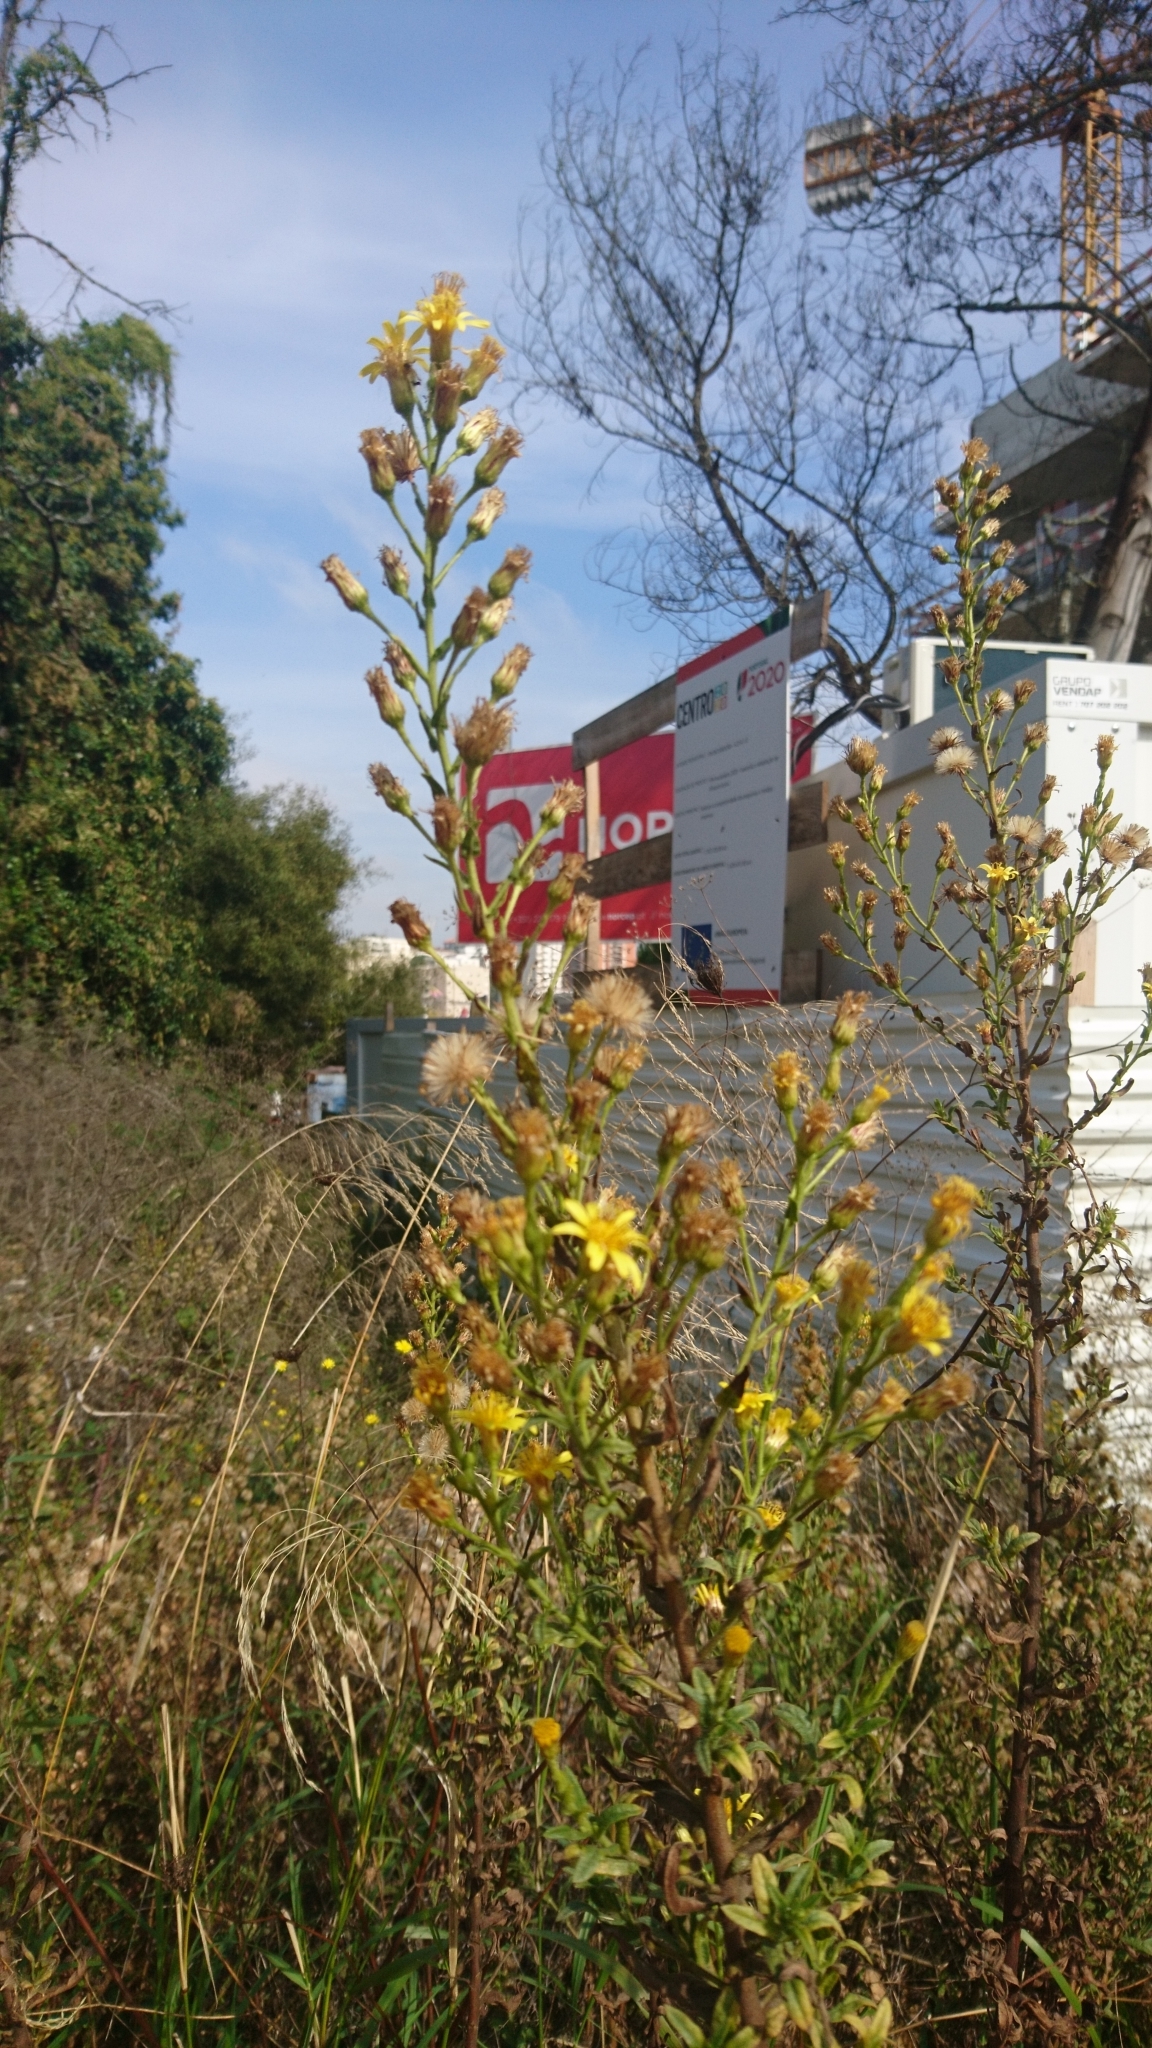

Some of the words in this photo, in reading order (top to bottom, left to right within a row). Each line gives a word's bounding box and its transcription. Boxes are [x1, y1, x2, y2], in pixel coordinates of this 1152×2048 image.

[747, 661, 786, 697] 2020
[1052, 676, 1091, 687] GRUPO
[1053, 686, 1102, 697] VENDAP
[676, 689, 714, 729] CENTRO
